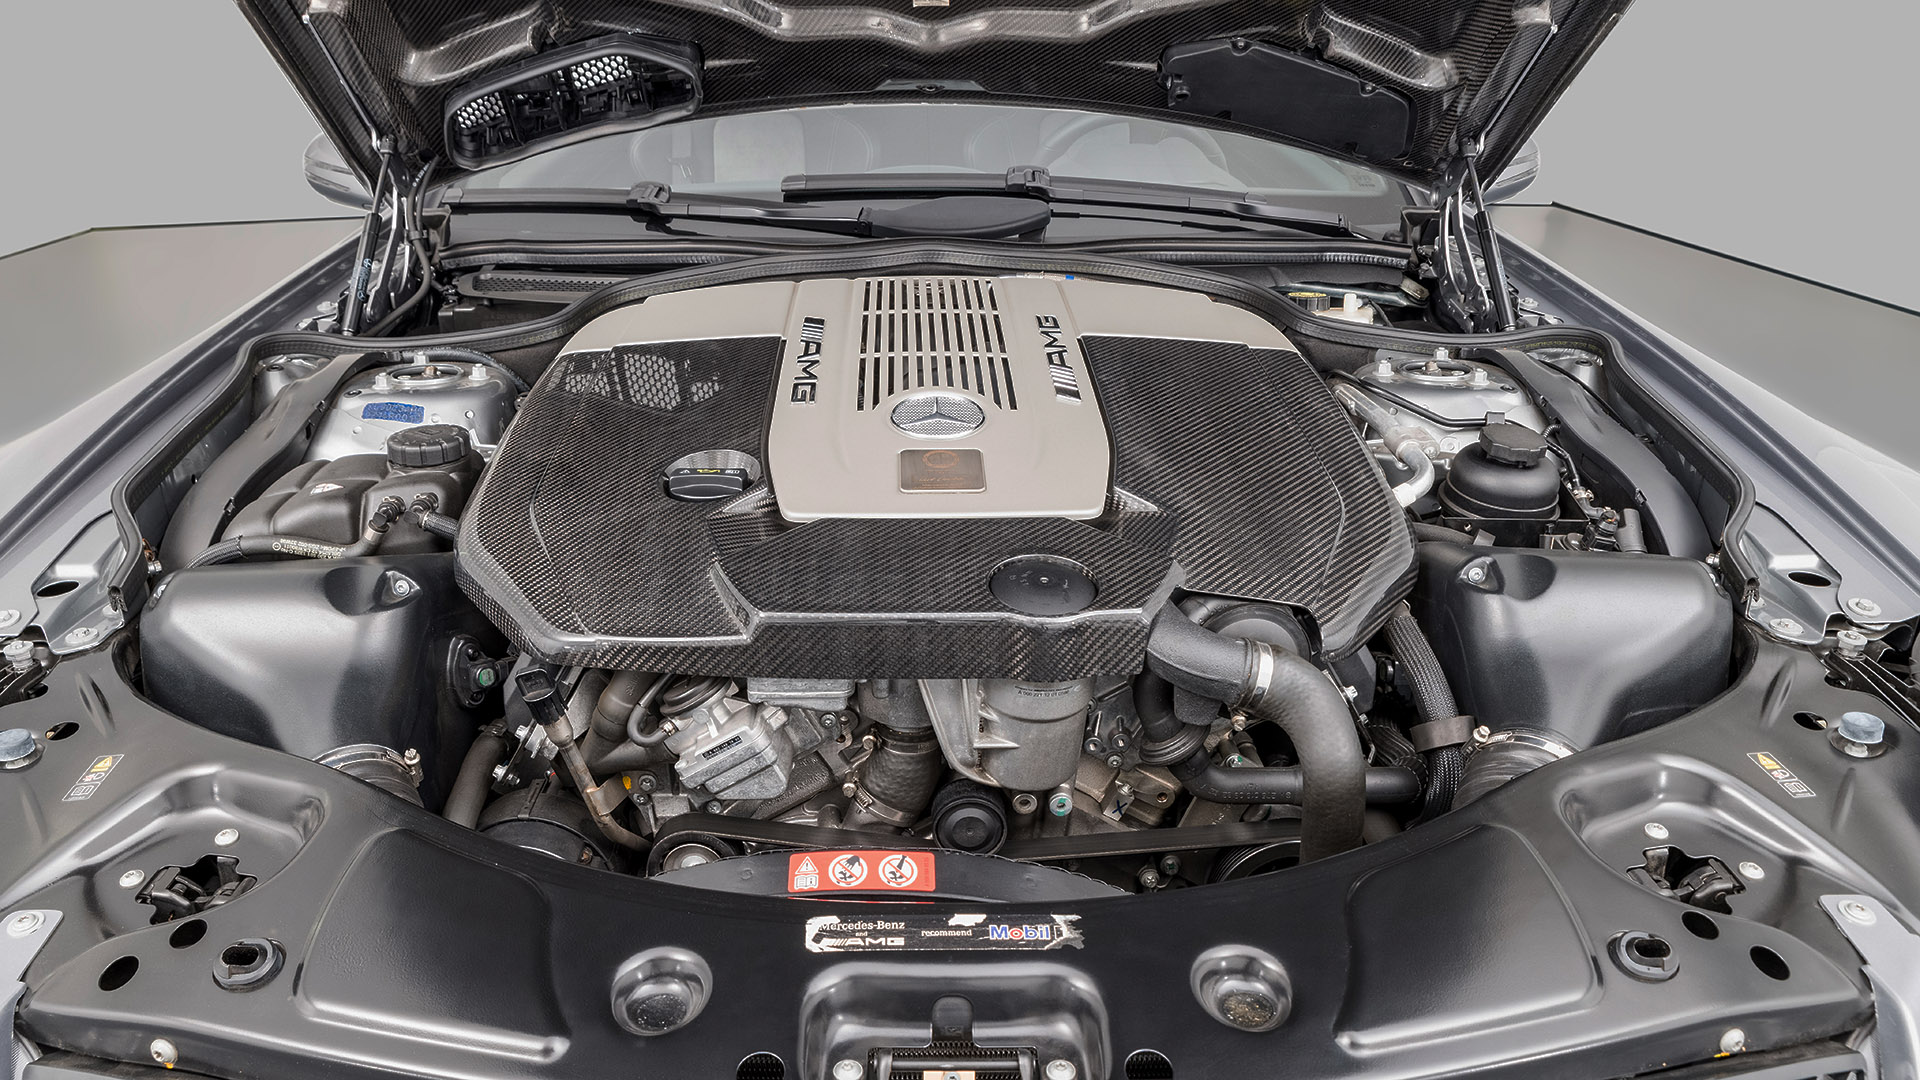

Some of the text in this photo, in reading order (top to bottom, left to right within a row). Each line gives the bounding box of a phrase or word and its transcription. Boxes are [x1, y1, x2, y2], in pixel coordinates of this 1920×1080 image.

[1035, 314, 1073, 374] AMG
[790, 333, 822, 404] AMG
[921, 929, 972, 937] recommend
[989, 925, 1051, 940] Mobil
